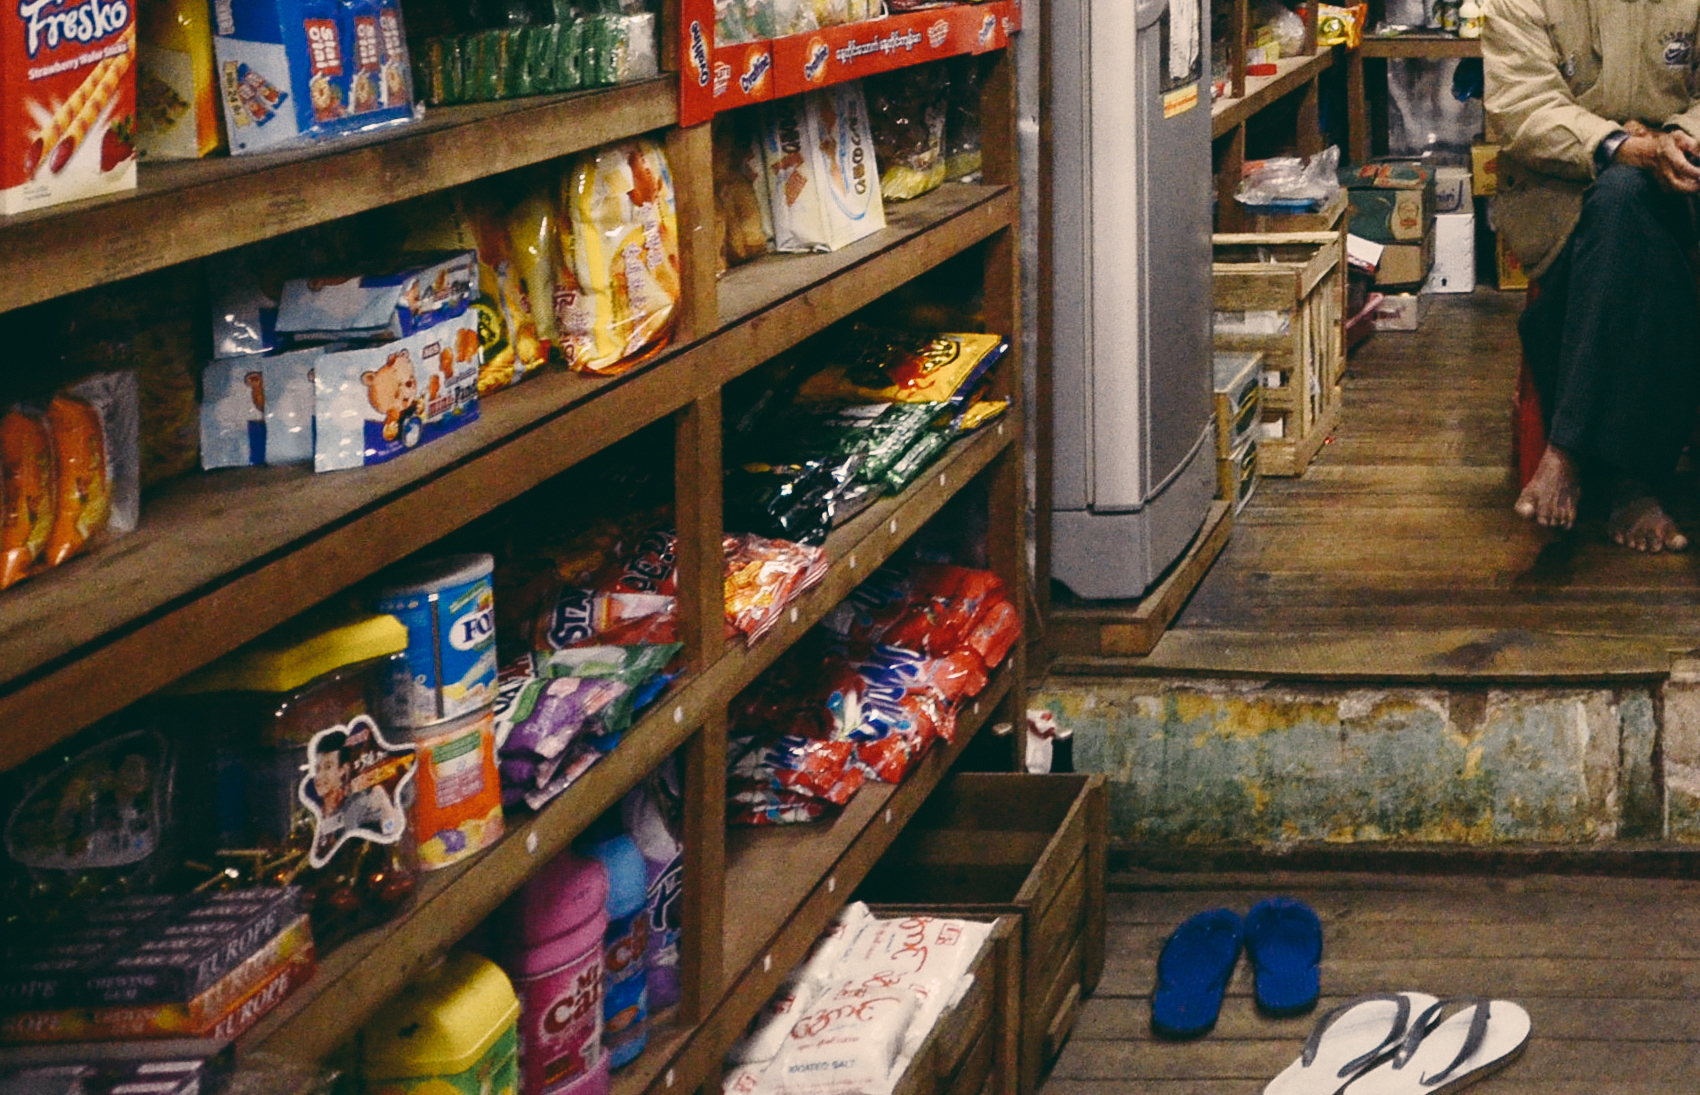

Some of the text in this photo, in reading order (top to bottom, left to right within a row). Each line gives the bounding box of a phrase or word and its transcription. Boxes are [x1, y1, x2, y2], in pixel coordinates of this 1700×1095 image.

[28, 40, 129, 81] Strawberry Wafer Sticks
[689, 20, 711, 88] Ovaltine
[740, 52, 771, 93] Ovaltine
[804, 43, 830, 82] Ovaltine
